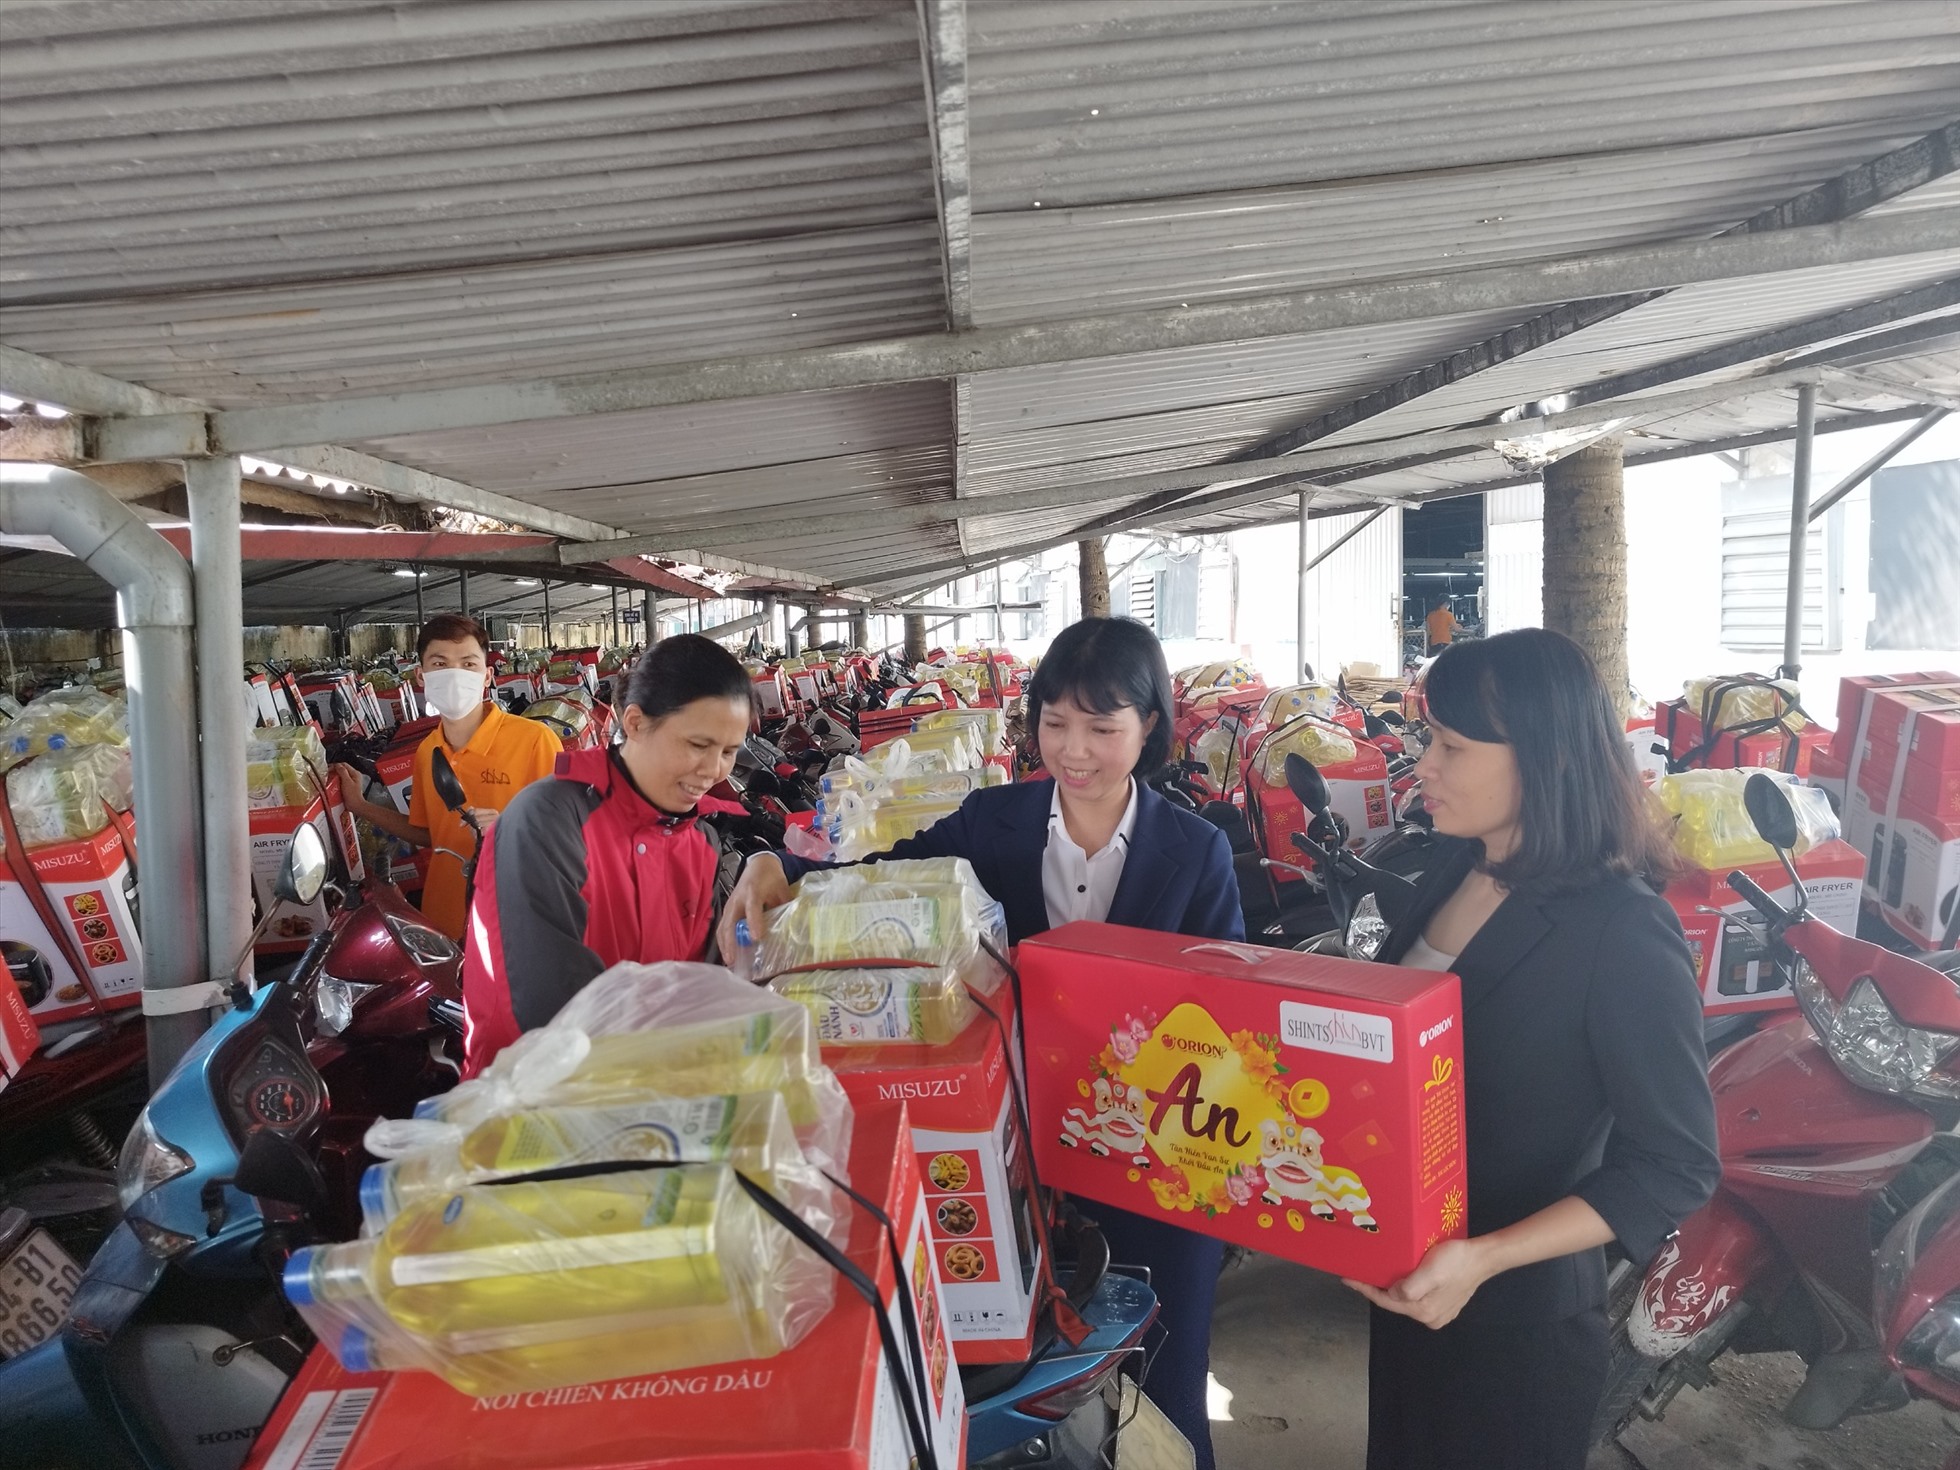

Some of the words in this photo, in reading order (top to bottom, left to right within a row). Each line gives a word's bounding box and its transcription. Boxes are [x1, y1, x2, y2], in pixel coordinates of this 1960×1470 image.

[383, 761, 410, 774] MISUZU
[254, 840, 269, 848] AIR
[33, 852, 84, 870] MISUZU
[1805, 885, 1819, 893] AIR
[1821, 882, 1853, 892] FRYER
[6, 991, 34, 1040] MISUZU
[1287, 1019, 1330, 1043] SHINTS
[1361, 1032, 1385, 1052] BVT
[1428, 1016, 1452, 1041] ORION
[1176, 1038, 1223, 1058] ORION
[879, 1078, 961, 1100] MISUZU
[1145, 1062, 1252, 1148] An
[611, 1375, 708, 1400] KHÔNG
[197, 1426, 262, 1445] HON
